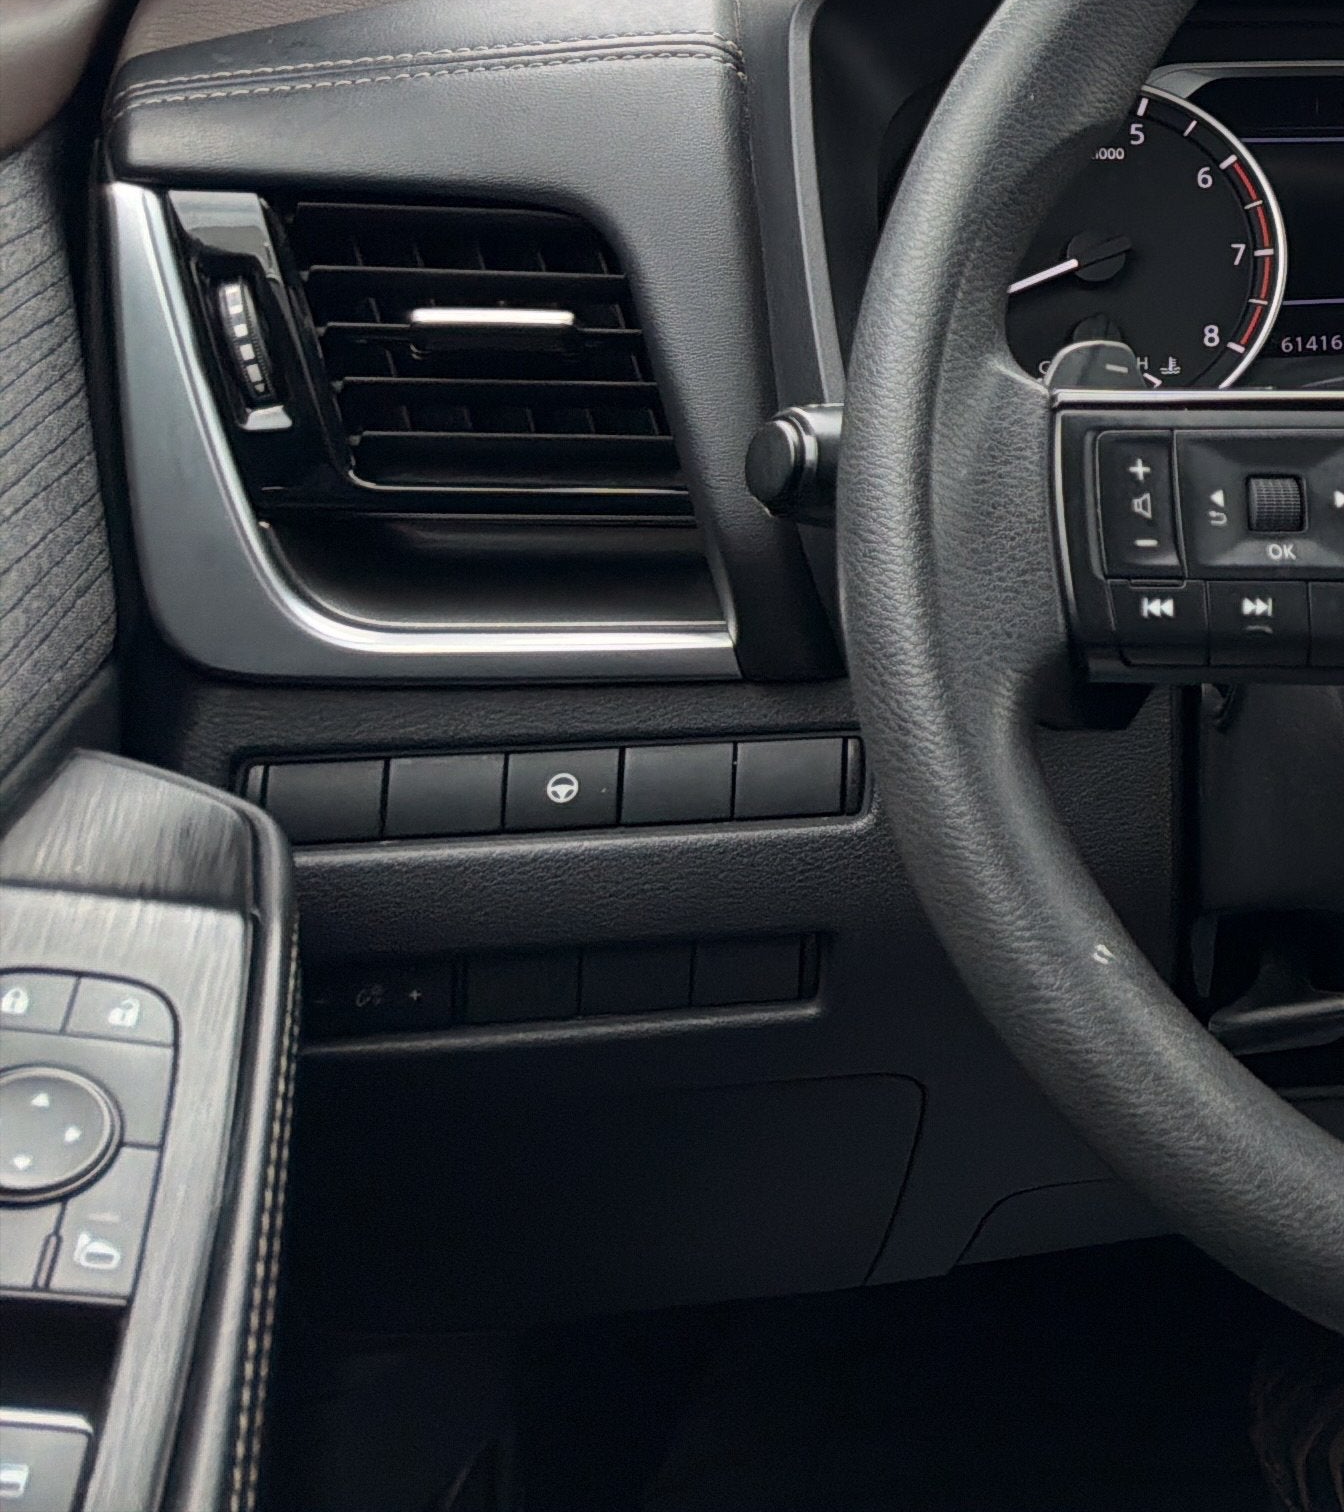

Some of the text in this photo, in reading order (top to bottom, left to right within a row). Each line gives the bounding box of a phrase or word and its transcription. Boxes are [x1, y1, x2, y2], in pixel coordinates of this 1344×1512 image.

[1128, 123, 1145, 146] 5
[1197, 166, 1214, 189] 6
[1230, 243, 1246, 266] 7
[1203, 324, 1220, 347] 8
[1280, 334, 1343, 354] 61416
[1266, 543, 1297, 561] OK
